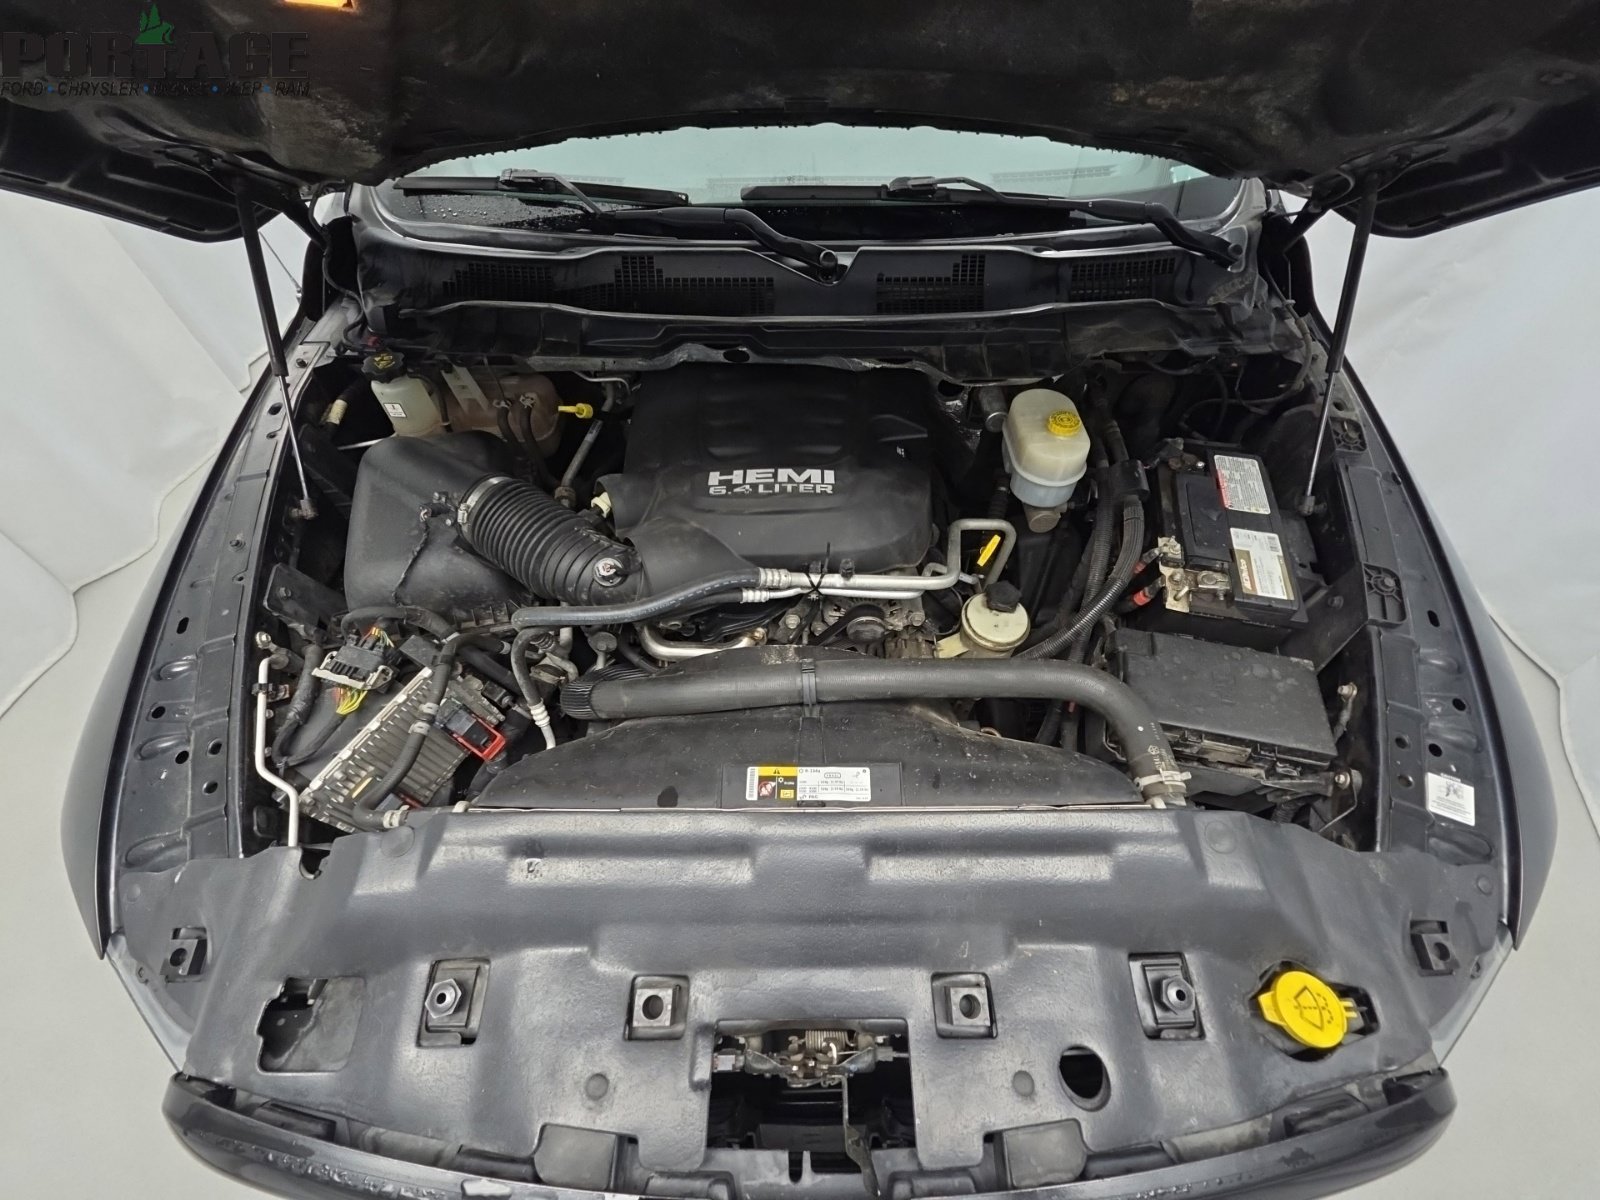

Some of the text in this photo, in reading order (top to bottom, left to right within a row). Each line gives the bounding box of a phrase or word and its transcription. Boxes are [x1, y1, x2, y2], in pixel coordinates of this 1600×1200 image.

[708, 468, 835, 485] HEMI
[709, 484, 833, 495] 6.4 LITER
